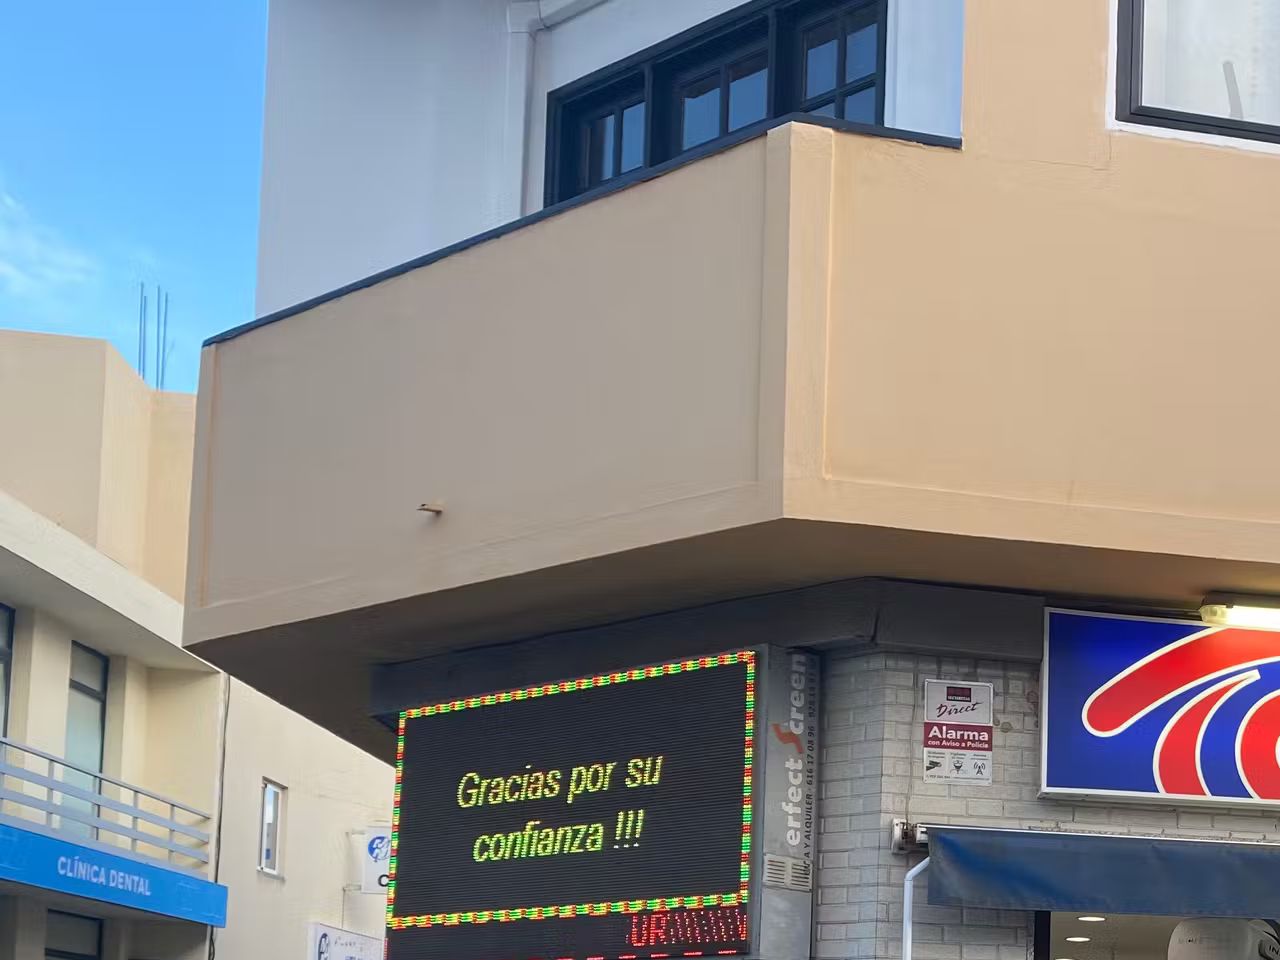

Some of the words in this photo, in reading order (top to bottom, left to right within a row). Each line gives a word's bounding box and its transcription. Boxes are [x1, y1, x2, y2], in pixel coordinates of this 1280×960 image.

[936, 702, 982, 718] Direct
[928, 726, 989, 741] Alarma
[457, 764, 562, 808] Gracias
[566, 761, 618, 804] por
[624, 755, 664, 788] su
[472, 820, 604, 862] confianza
[57, 855, 106, 886] CLÍNICA
[109, 869, 152, 897] DENTAL
